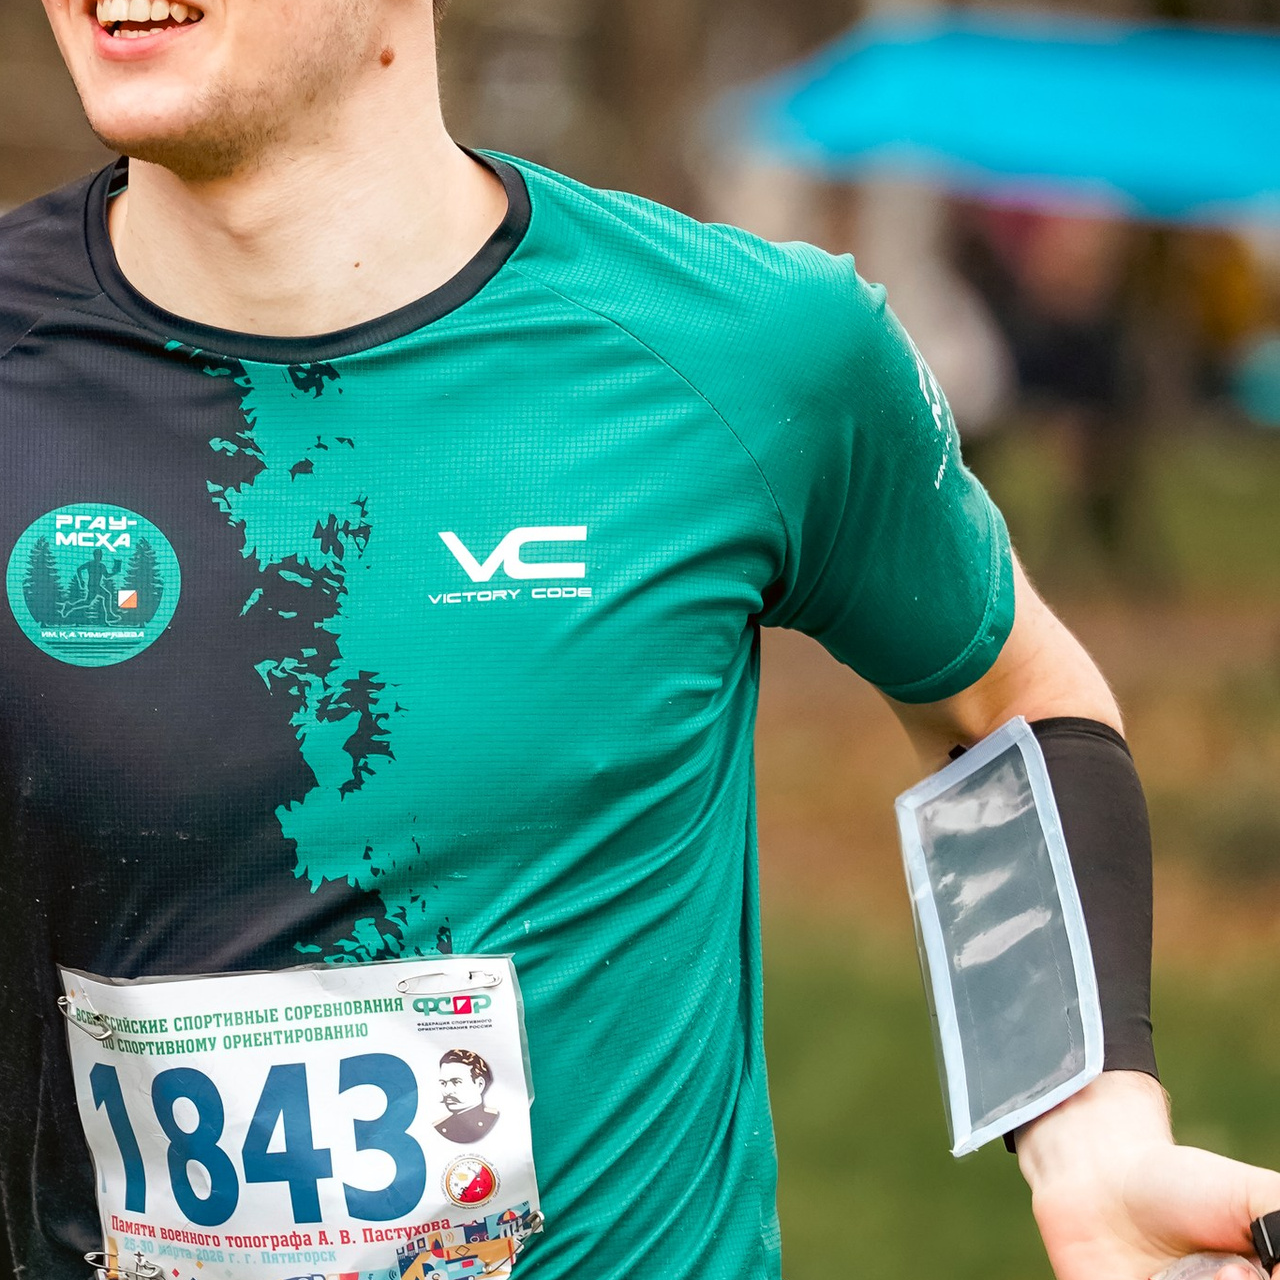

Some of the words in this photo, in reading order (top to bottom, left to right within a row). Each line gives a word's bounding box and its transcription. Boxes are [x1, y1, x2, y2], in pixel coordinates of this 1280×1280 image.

[55, 514, 137, 530] РГАУ-
[55, 532, 131, 552] МСХА
[438, 525, 587, 582] VC
[428, 589, 520, 604] VICTORY
[531, 587, 592, 598] CODE
[174, 1008, 279, 1031] СПОРТИВНЫЕ
[284, 997, 404, 1021] СОРЕВНОВАНИЯ
[119, 1036, 217, 1056] СПОРТИВНОМУ
[223, 1022, 368, 1050] ОРИЕНТИРОВАНИЮ
[89, 1052, 427, 1227] 1843
[111, 1215, 156, 1238] Памяти
[160, 1227, 220, 1247] военного
[225, 1231, 313, 1250] топографа
[318, 1230, 334, 1245] А.
[339, 1229, 356, 1244] В.
[362, 1218, 451, 1243] Пастухова
[124, 1237, 154, 1254] 25-30
[261, 1250, 337, 1266] Пятигорск
